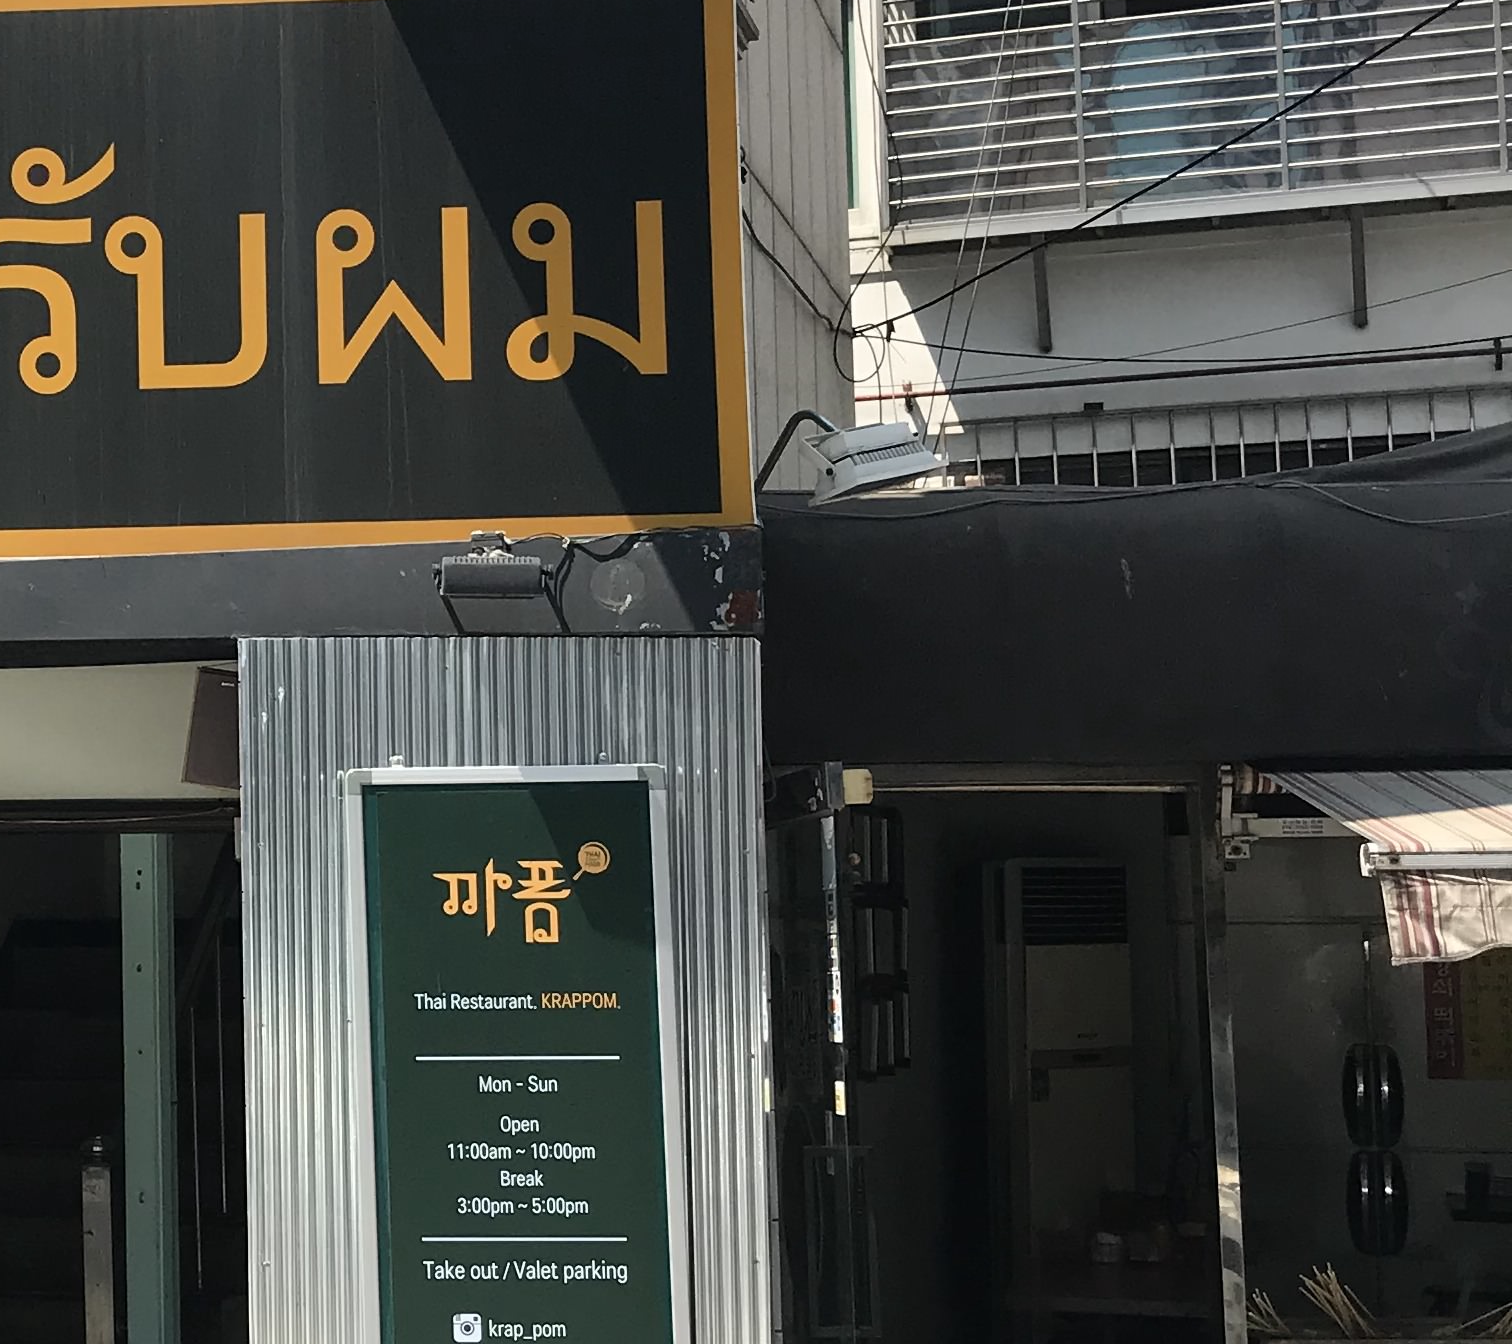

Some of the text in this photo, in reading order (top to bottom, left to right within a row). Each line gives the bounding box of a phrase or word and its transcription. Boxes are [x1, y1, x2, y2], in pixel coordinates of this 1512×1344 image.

[414, 992, 621, 1010] Thai Restaurant. KRAPPOM.
[479, 1076, 511, 1093] Mon
[528, 1076, 558, 1093] Sun
[500, 1116, 539, 1135] Open
[447, 1143, 512, 1160] 11:00am
[530, 1143, 596, 1163] 10:00pm
[500, 1170, 544, 1187] Break
[457, 1197, 514, 1217] 3:00pm
[531, 1197, 589, 1217] 5:00pm
[423, 1260, 465, 1279] Take
[470, 1263, 499, 1280] out
[513, 1260, 558, 1280] Valet
[563, 1260, 628, 1283] parking
[488, 1320, 567, 1341] krap_pom
